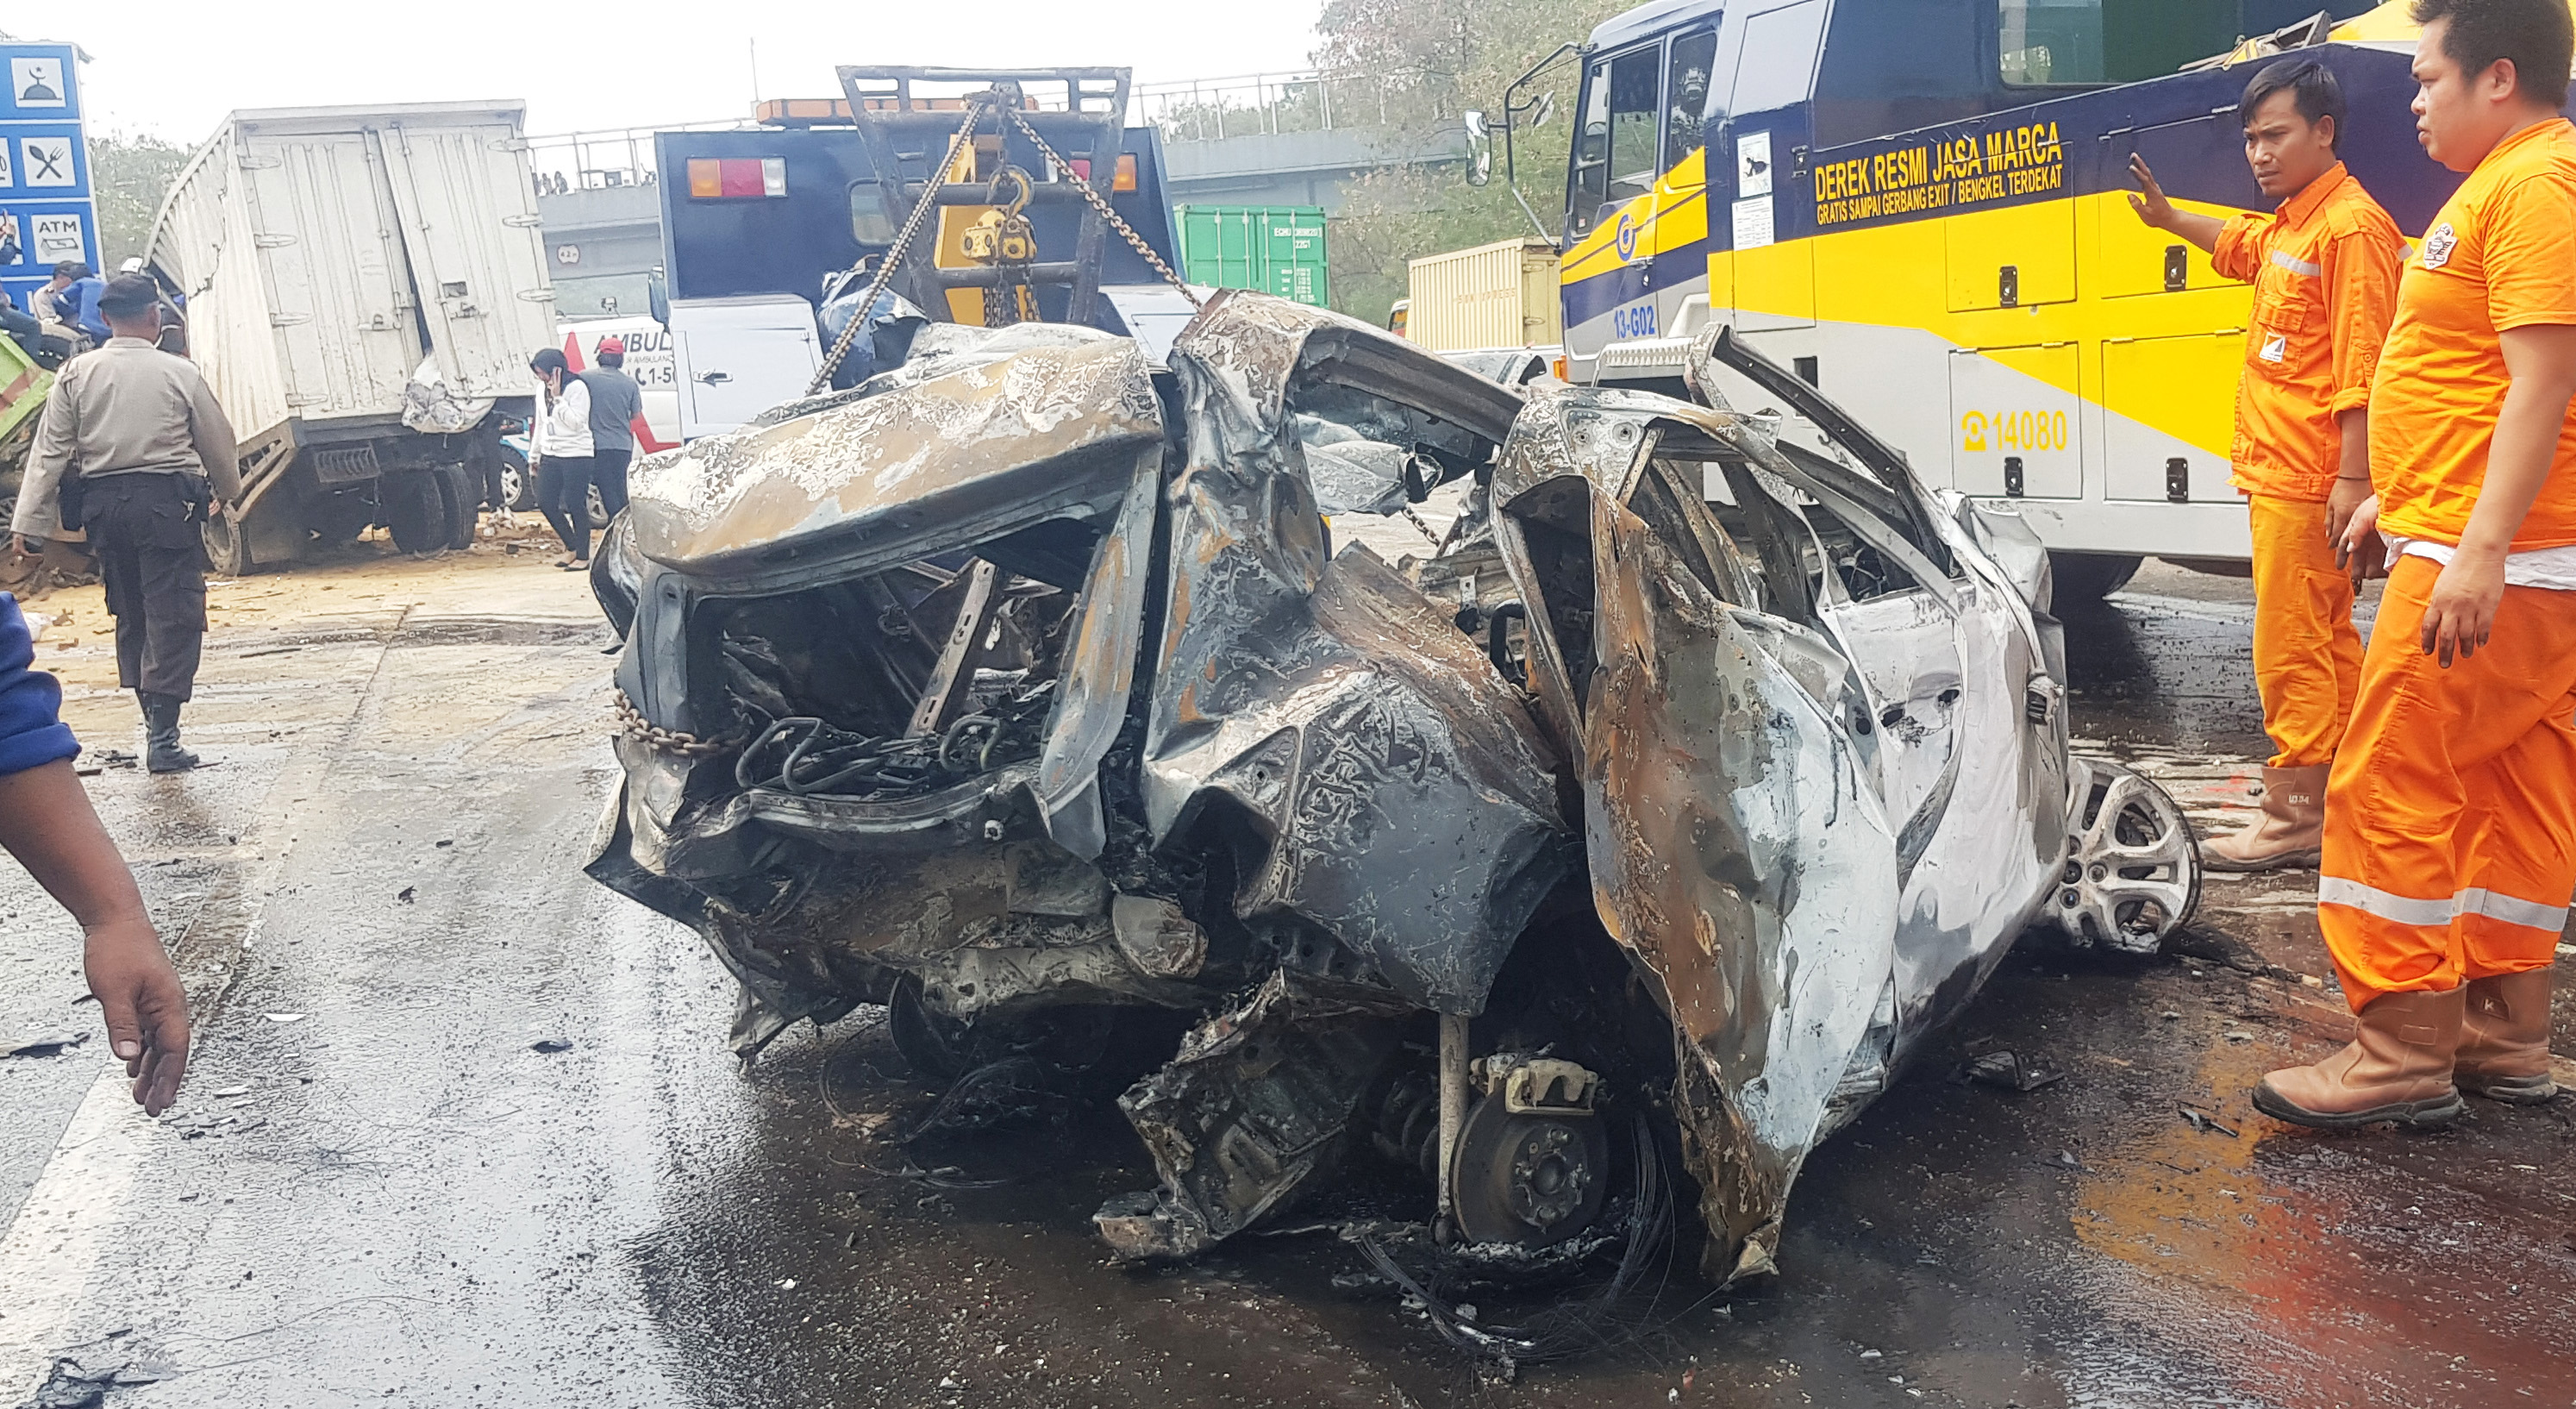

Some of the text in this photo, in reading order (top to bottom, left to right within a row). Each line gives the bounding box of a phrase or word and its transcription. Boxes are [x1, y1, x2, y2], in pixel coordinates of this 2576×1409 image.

[1815, 157, 1870, 202] DEREK
[1874, 146, 1928, 191] RESMI
[1932, 136, 1982, 182] JASA
[1985, 122, 2062, 172] MARGA
[1816, 200, 1848, 225] GRATIS
[1848, 194, 1881, 220] SAMPAI
[1882, 186, 1927, 215] GERBANG
[1928, 183, 1950, 208] EXIT
[1958, 174, 2006, 204] BENGKEL
[2007, 163, 2063, 196] TERDEKAT
[39, 221, 78, 233] ATM
[1615, 305, 1655, 339] 13-G02
[1992, 410, 2067, 451] 14080
